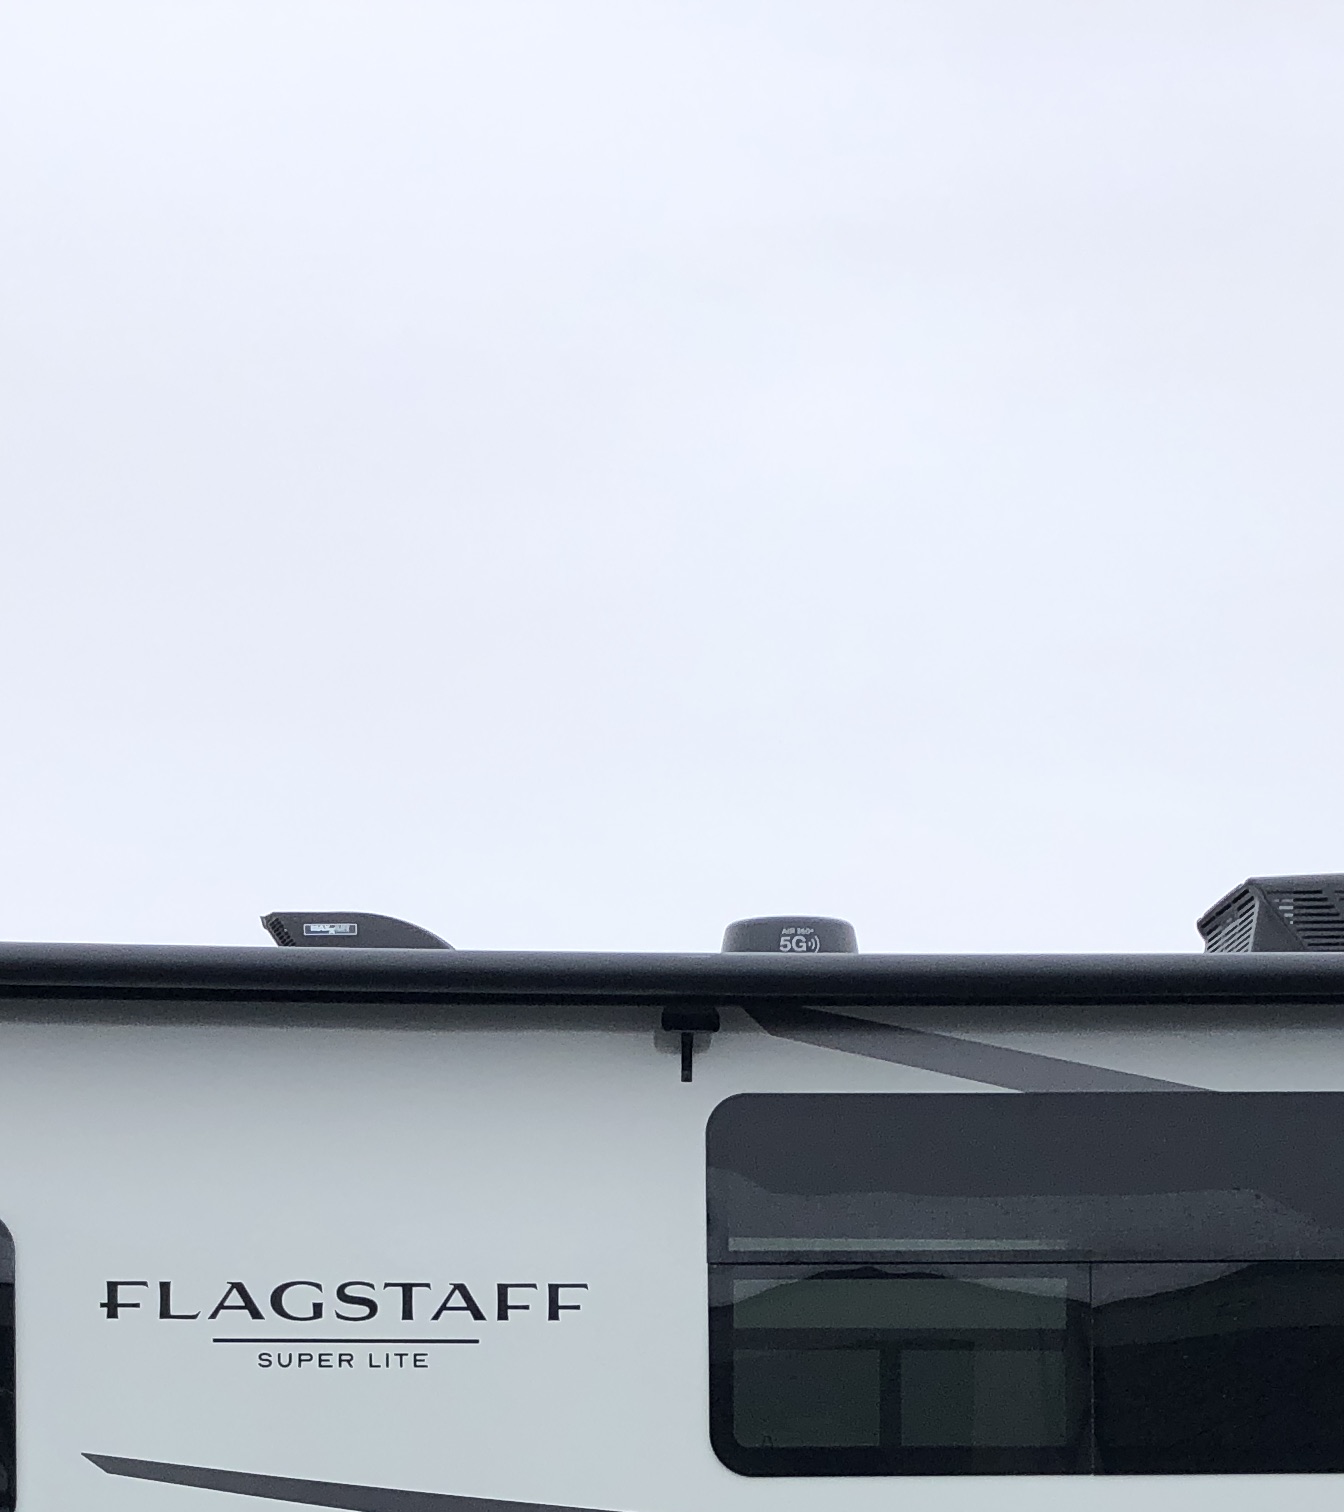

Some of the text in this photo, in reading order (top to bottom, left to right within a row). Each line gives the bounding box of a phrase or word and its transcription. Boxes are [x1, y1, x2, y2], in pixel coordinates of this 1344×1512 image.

[779, 935, 807, 952] 5G
[99, 1280, 589, 1322] FLAGSTAFF
[257, 1352, 430, 1369] SUPER LITE
